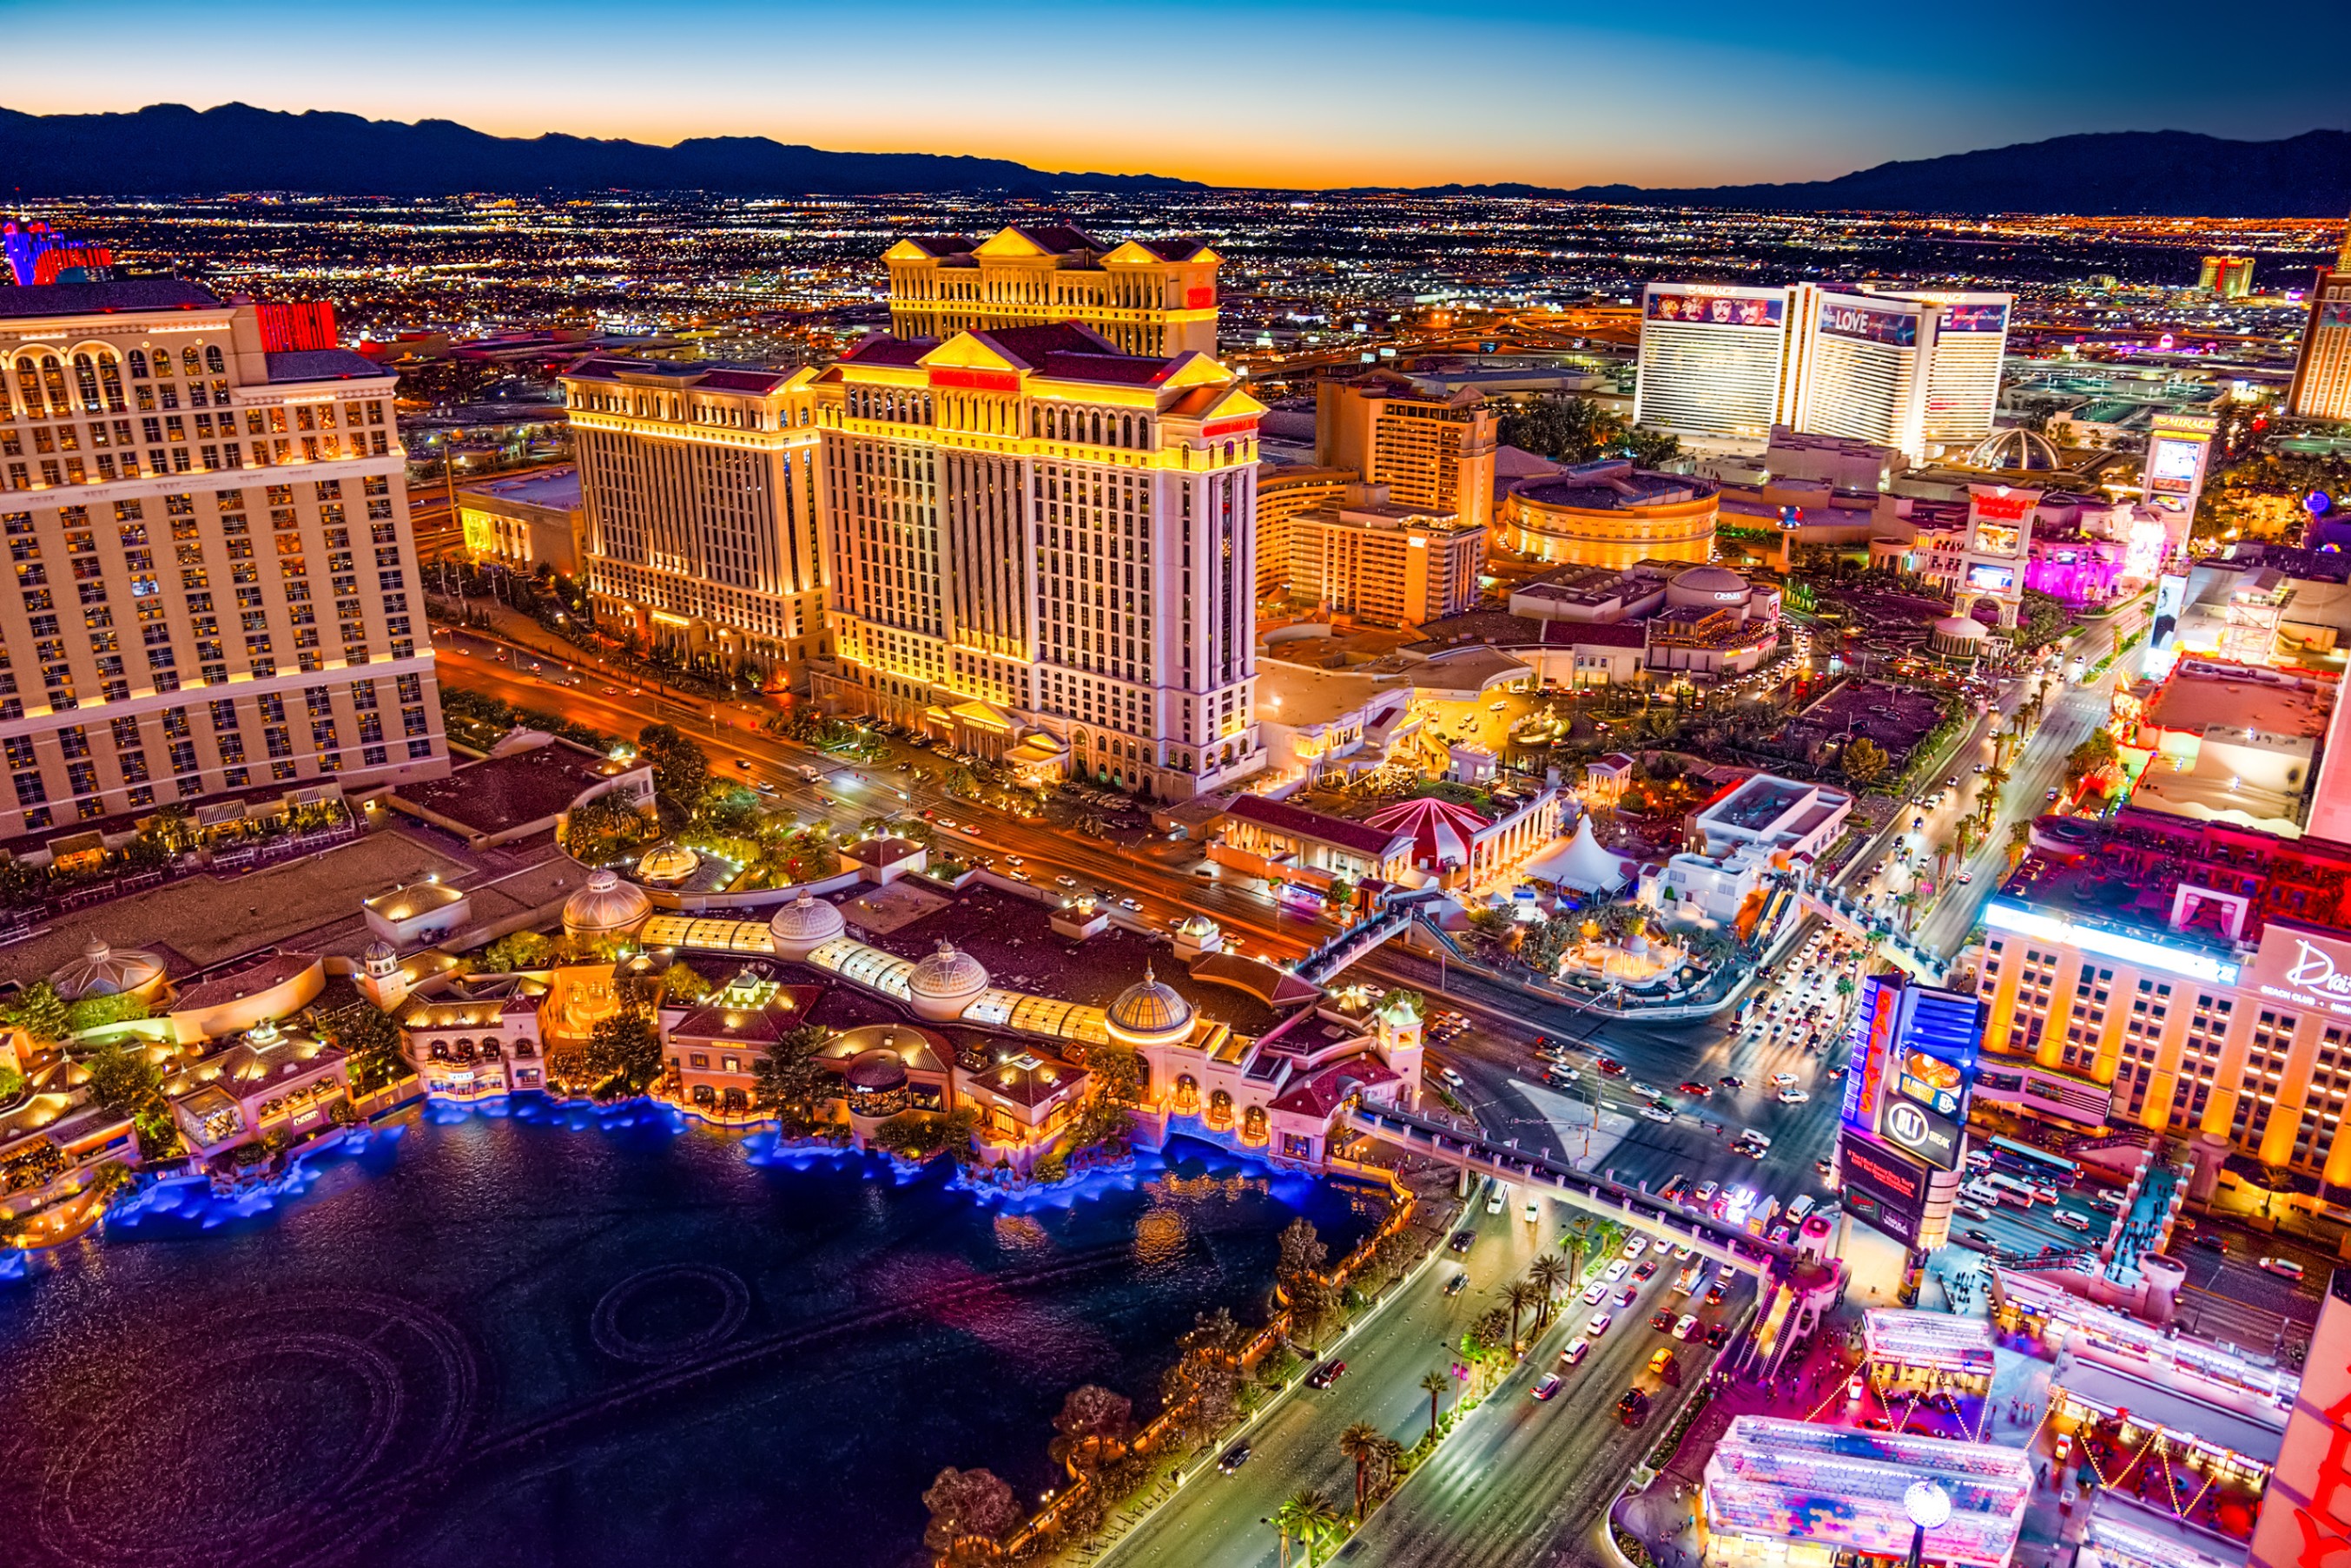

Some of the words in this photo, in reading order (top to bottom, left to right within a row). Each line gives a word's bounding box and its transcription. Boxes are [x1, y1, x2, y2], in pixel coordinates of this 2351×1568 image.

[1696, 285, 1737, 296] MIRAGE
[1925, 293, 1966, 304] MIRAGE
[1835, 310, 1869, 333] LOVE
[2166, 417, 2216, 429] MIRAGE
[2286, 939, 2351, 1000] Drai
[2261, 985, 2292, 1000] BEACH
[2291, 993, 2316, 1006] CLUB
[1896, 1108, 1922, 1139] BLT
[1928, 1130, 1951, 1150] STEAK
